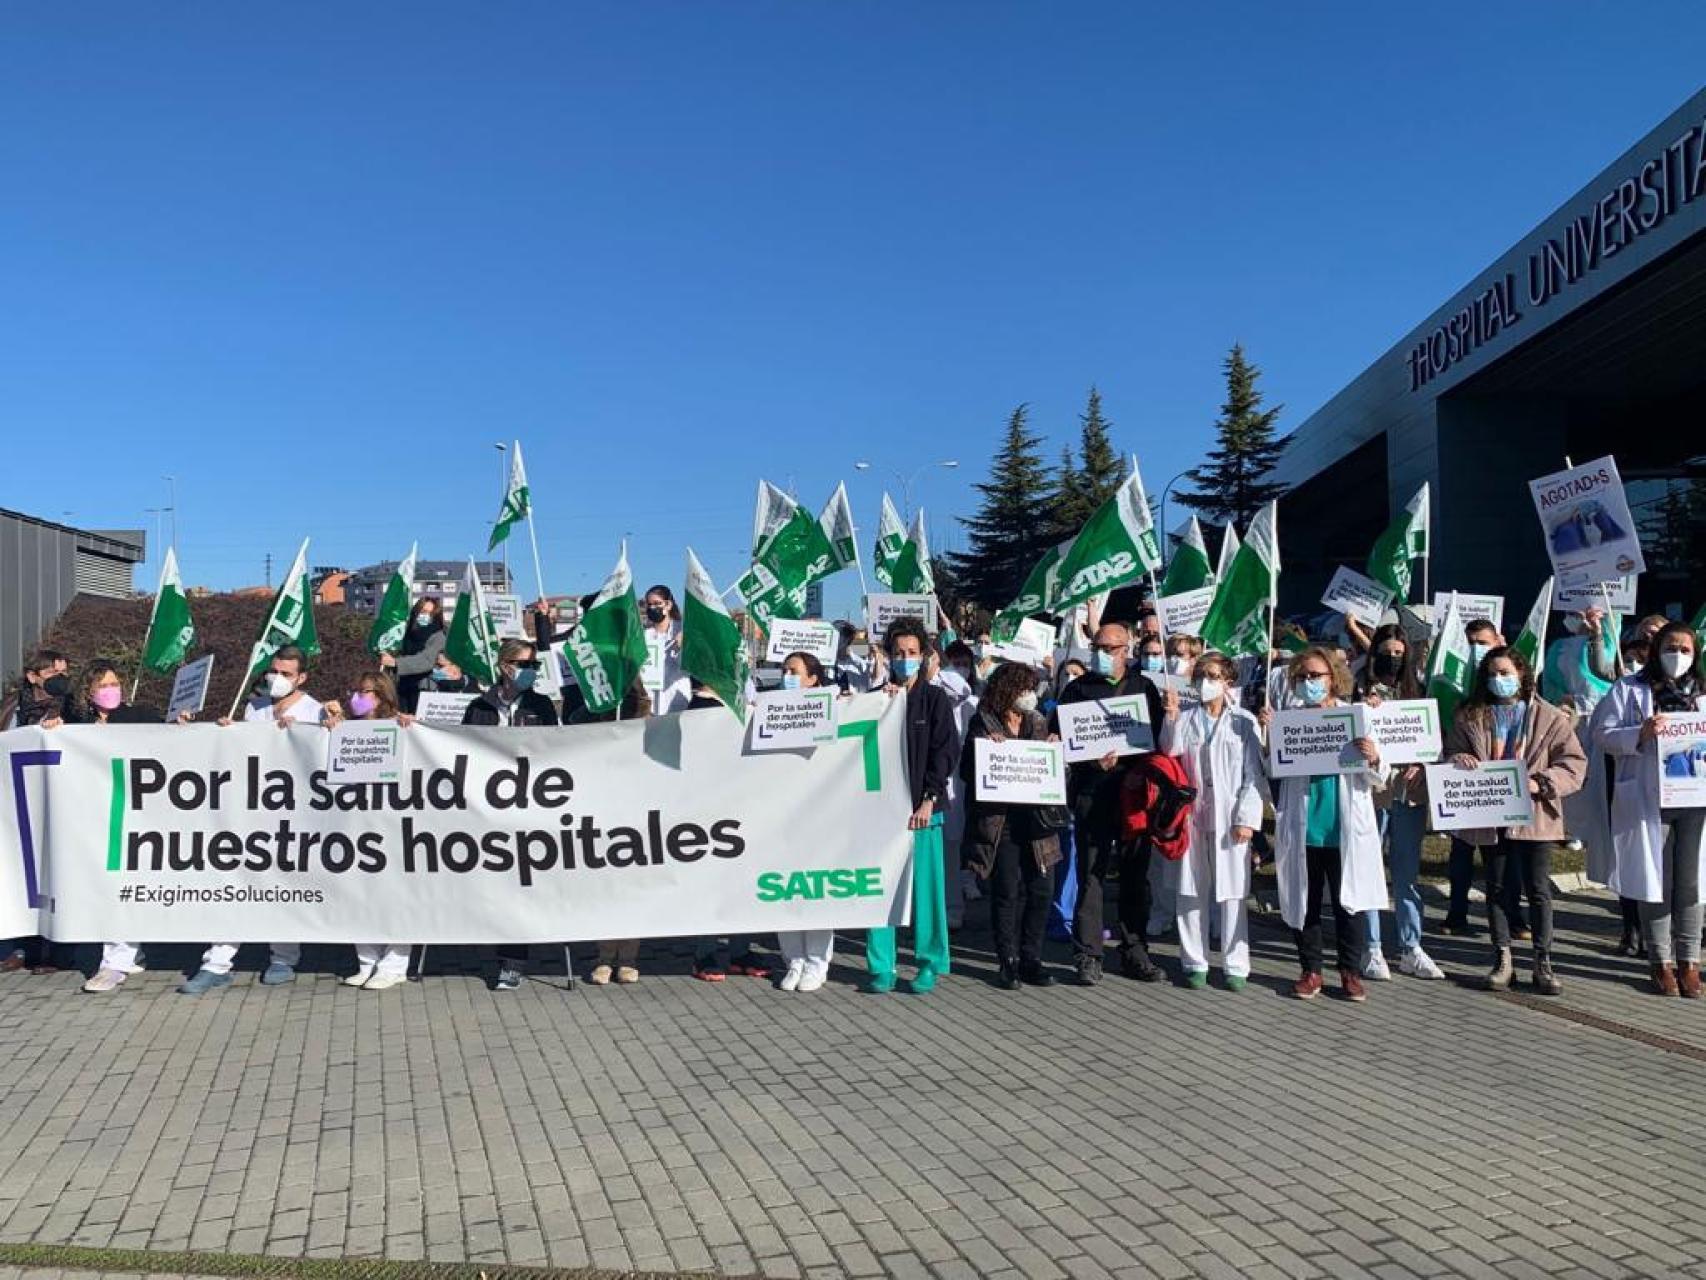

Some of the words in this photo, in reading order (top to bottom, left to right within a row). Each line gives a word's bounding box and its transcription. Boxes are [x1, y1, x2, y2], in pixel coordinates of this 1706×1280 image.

[1416, 272, 1521, 387] HOSPITAL
[767, 704, 784, 713] Por
[785, 703, 796, 712] la
[796, 701, 823, 711] salud
[766, 713, 780, 722] de
[781, 711, 825, 721] nuestros
[1073, 715, 1090, 725] Por
[1091, 714, 1101, 723] la
[1393, 714, 1422, 725] salud
[765, 720, 817, 732] hospitales
[1074, 724, 1089, 735] de
[1283, 726, 1302, 736] Por
[1303, 725, 1314, 734] la
[1315, 722, 1346, 733] salud
[1380, 726, 1425, 735] nuestros
[341, 736, 355, 745] Por
[356, 736, 365, 745] la
[366, 735, 389, 746] salud
[1284, 736, 1298, 746] de
[1300, 734, 1349, 744] nuestros
[1379, 734, 1417, 746] spitales
[340, 746, 351, 754] de
[352, 746, 390, 754] nuestros
[1285, 744, 1341, 756] hospitales
[340, 754, 384, 765] hospitales
[989, 753, 1006, 763] Por
[1008, 754, 1019, 763] la
[989, 763, 1004, 772] de
[1005, 764, 1050, 775] nuestros
[129, 757, 232, 812] Por
[247, 755, 296, 812] la
[484, 756, 575, 810] de
[1443, 779, 1462, 789] Por
[1464, 778, 1475, 788] la
[1477, 776, 1509, 786] salud
[1444, 788, 1460, 799] de
[1462, 787, 1513, 798] nuestros
[1445, 797, 1505, 811] hospitales
[126, 819, 388, 874] nuestros
[401, 808, 746, 887] hospitales
[755, 866, 884, 902] SATSE
[119, 884, 324, 907] #ExigimosSoluciones
